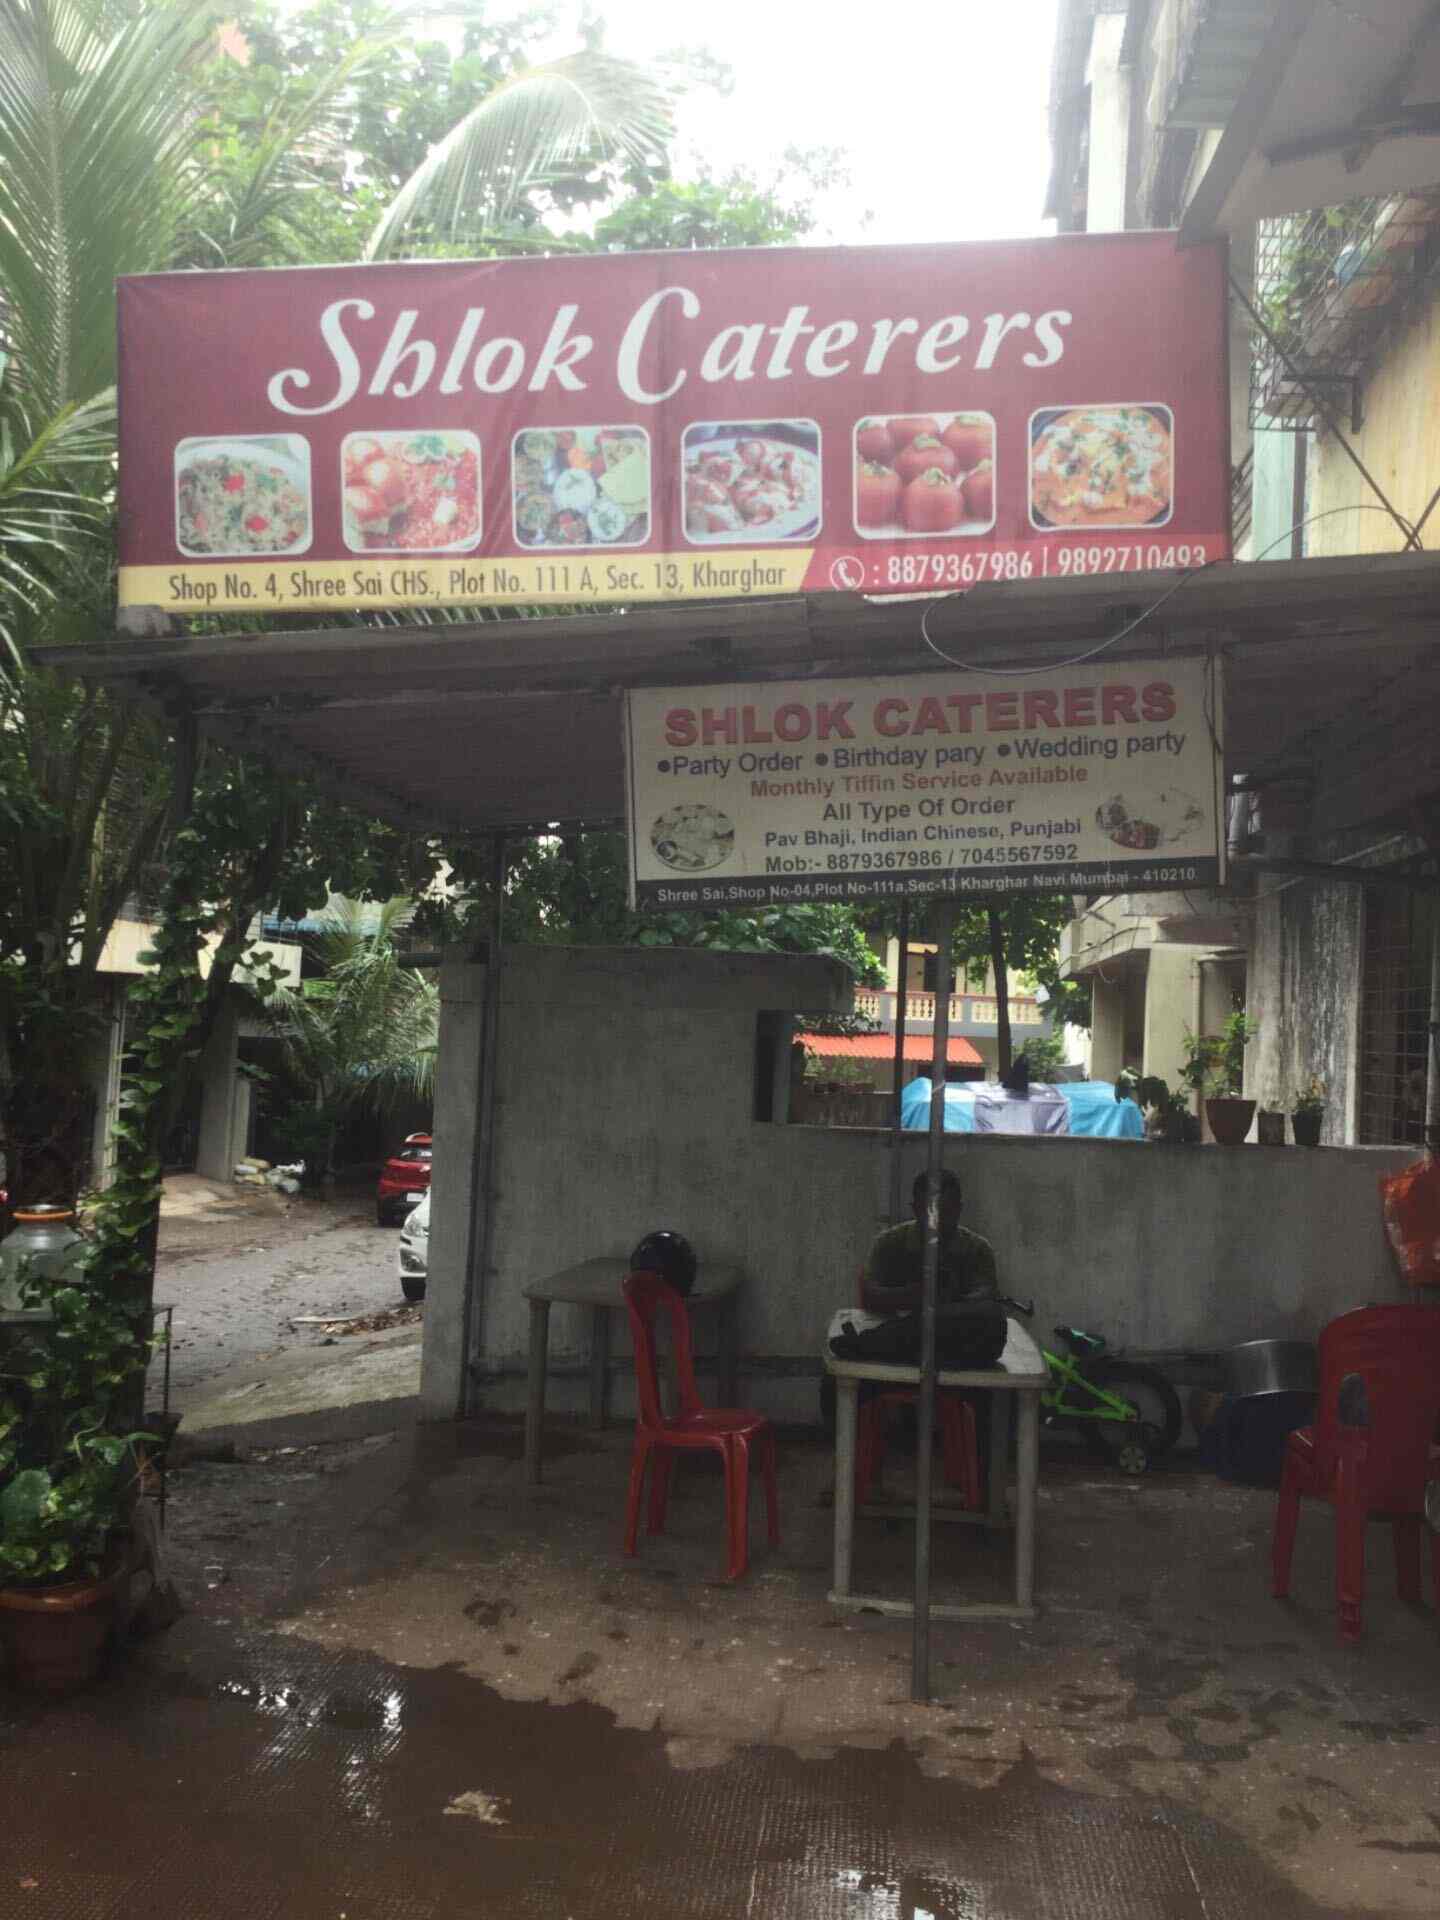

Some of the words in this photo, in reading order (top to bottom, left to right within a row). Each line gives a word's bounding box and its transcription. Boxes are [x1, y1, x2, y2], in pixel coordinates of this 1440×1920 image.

[267, 298, 594, 417] Shlok
[615, 285, 1073, 405] Caterers
[169, 573, 217, 604] Shop
[225, 573, 257, 599] No.
[265, 573, 283, 602] 4,
[291, 570, 346, 599] Shree
[354, 570, 382, 596] Sai
[450, 567, 486, 594] Plot
[493, 567, 525, 594] No.
[535, 566, 570, 592] 111
[608, 564, 645, 591] Sec.
[654, 563, 684, 592] 13,
[693, 559, 788, 592] Kharghar
[664, 701, 857, 748] SHLOK
[873, 682, 1177, 739] CATERERS
[673, 754, 731, 778] Party
[738, 751, 803, 774] Order
[834, 746, 928, 771] Birthday
[936, 744, 985, 769] pary
[1014, 733, 1118, 760] Wedding
[1126, 731, 1186, 757] party
[751, 776, 834, 799] Monthly
[842, 773, 895, 794] Tiffin
[902, 769, 981, 791] Service
[988, 764, 1088, 786] Available
[822, 803, 851, 821] All
[858, 800, 911, 823] Type
[918, 798, 944, 817] Of
[951, 795, 1016, 815] Order
[765, 830, 798, 847] Pav
[862, 825, 917, 844] Indian
[1010, 818, 1081, 839] Punjabi
[827, 849, 942, 870] 8879367986
[961, 844, 1078, 865] 7045567592
[657, 888, 698, 902] Shree
[961, 876, 1028, 893] Kharghar
[1033, 874, 1065, 887] Navi
[1070, 870, 1129, 886] Mumbai
[1143, 867, 1196, 882] 410210
